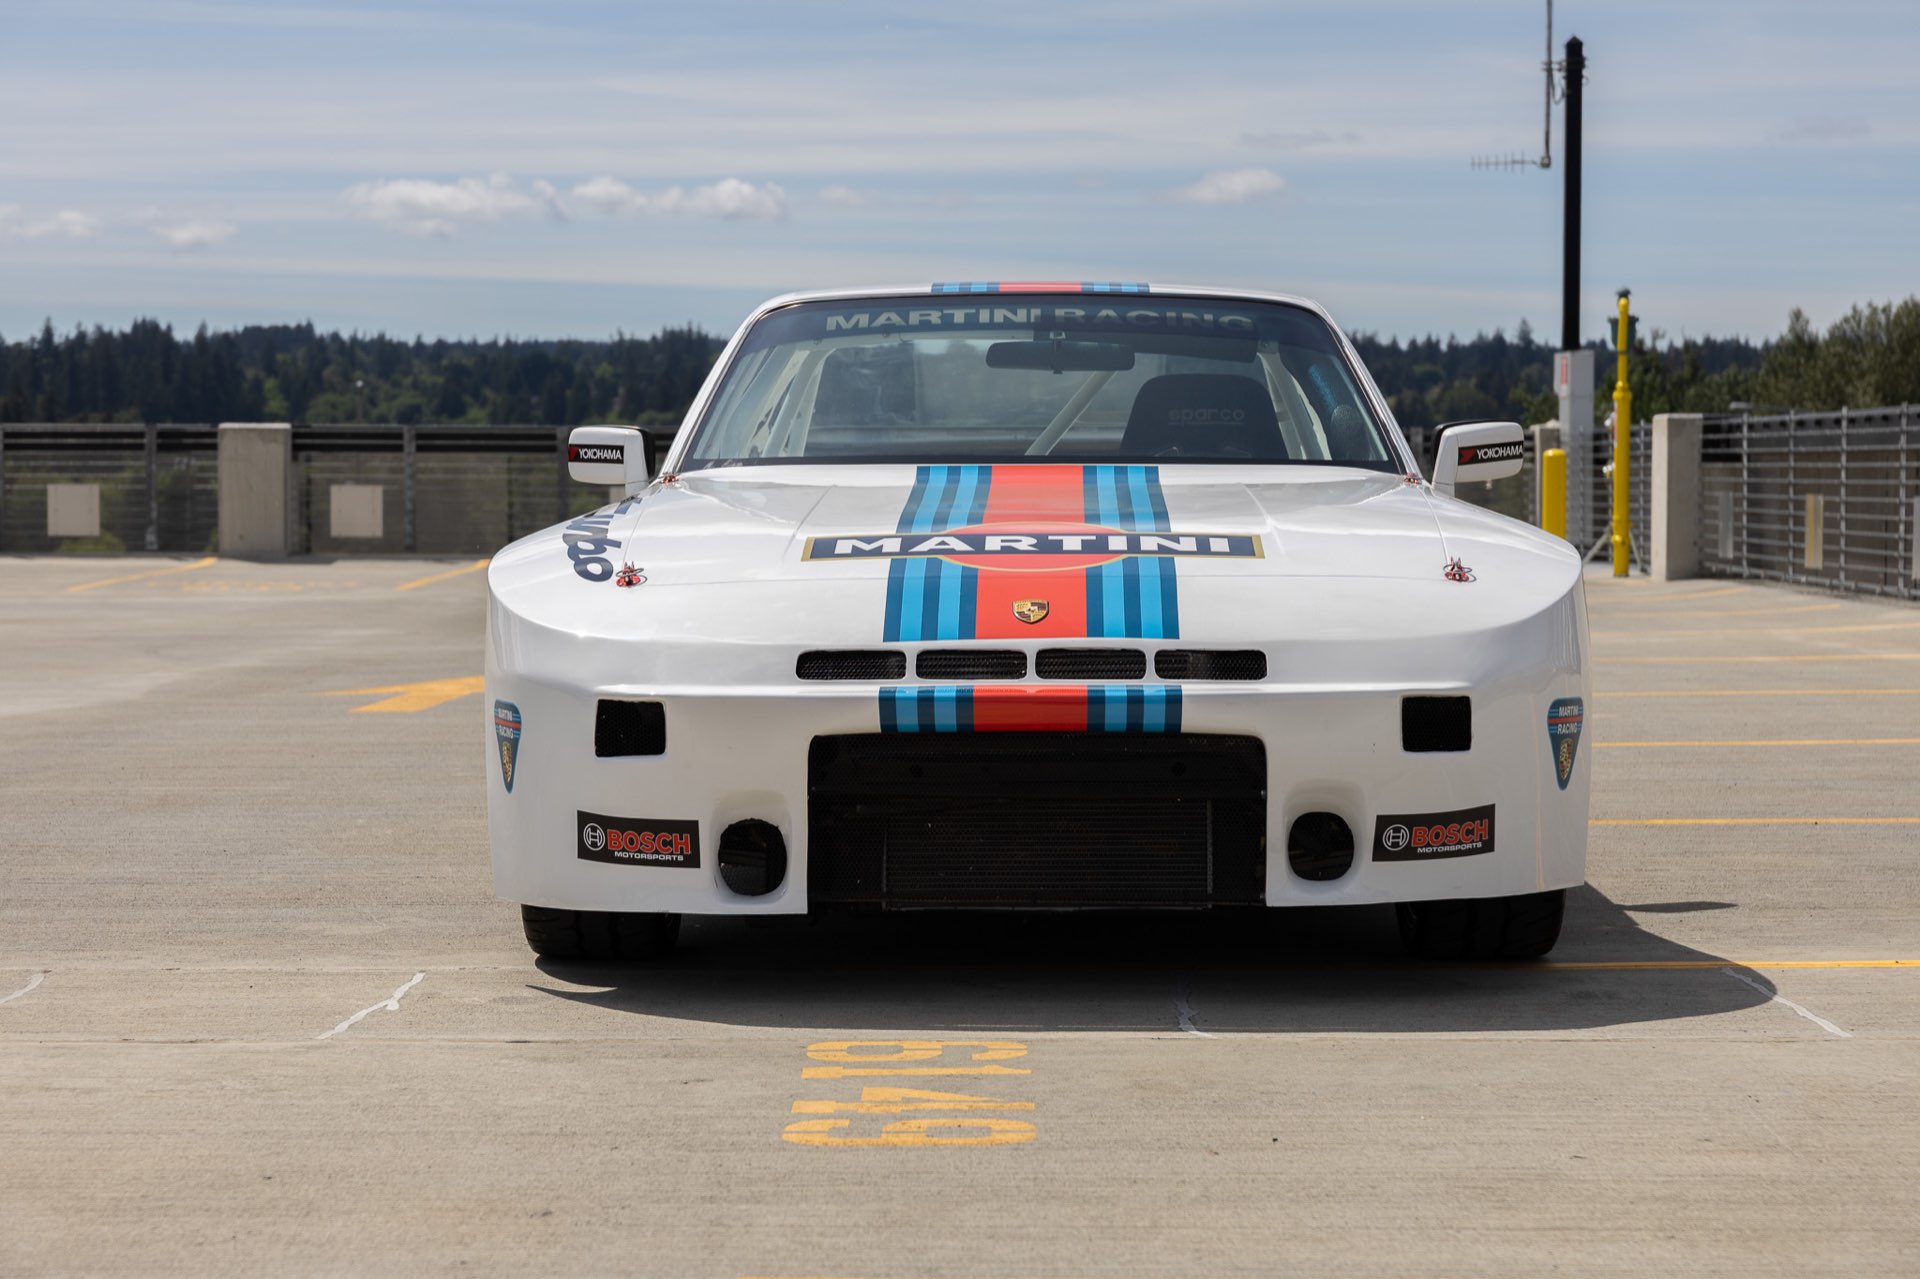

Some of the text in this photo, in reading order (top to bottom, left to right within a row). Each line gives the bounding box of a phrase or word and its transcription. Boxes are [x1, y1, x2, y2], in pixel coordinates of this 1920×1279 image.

[825, 307, 1254, 331] MARTINI RACING
[1168, 408, 1246, 428] sparco
[578, 448, 622, 460] YOKOHAMA
[833, 535, 1231, 555] MARTINI
[1557, 722, 1578, 735] RACING
[606, 828, 691, 855] BOSCH
[1410, 818, 1489, 847] BOSCH
[614, 851, 684, 861] MOTORSPORTS
[1417, 841, 1483, 853] MOTORSPORTS
